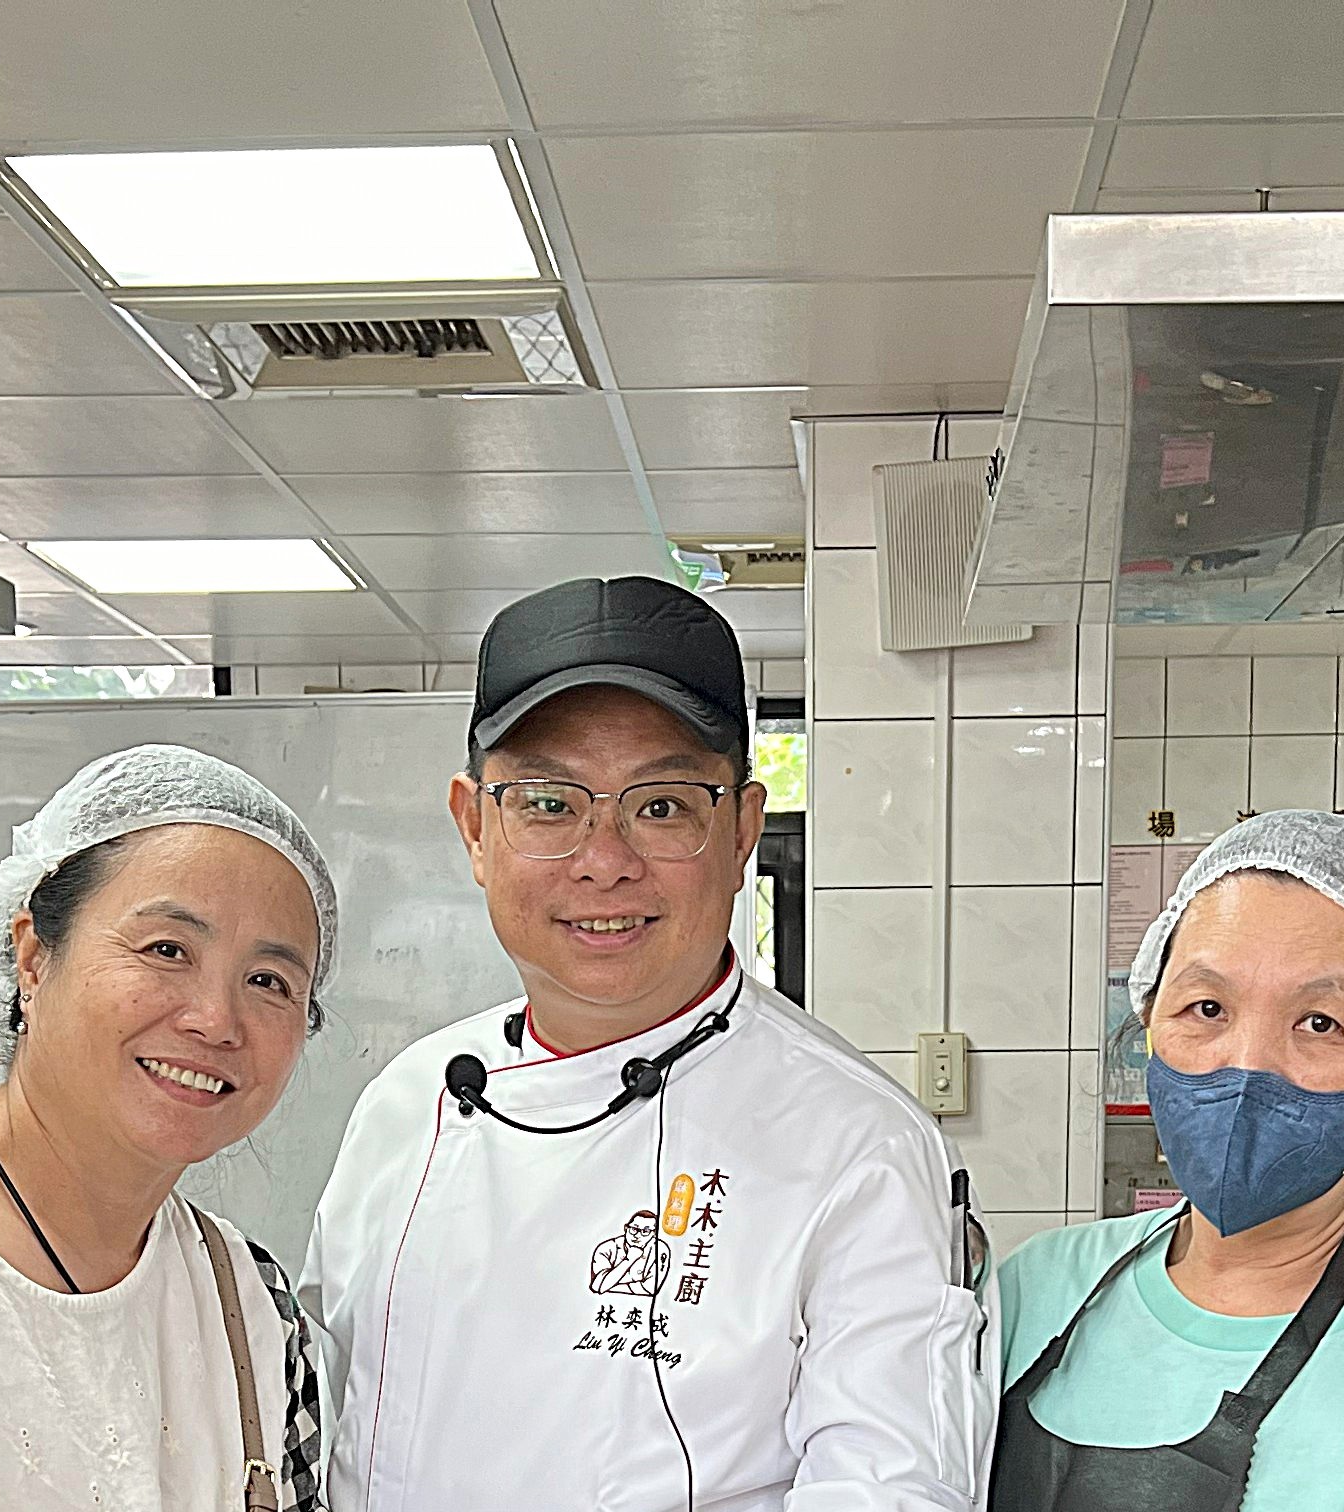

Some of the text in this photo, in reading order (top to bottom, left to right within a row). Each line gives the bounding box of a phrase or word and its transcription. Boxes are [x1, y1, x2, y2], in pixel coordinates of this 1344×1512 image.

[595, 1304, 670, 1338] 林奕成
[631, 1338, 682, 1369] Cheng
